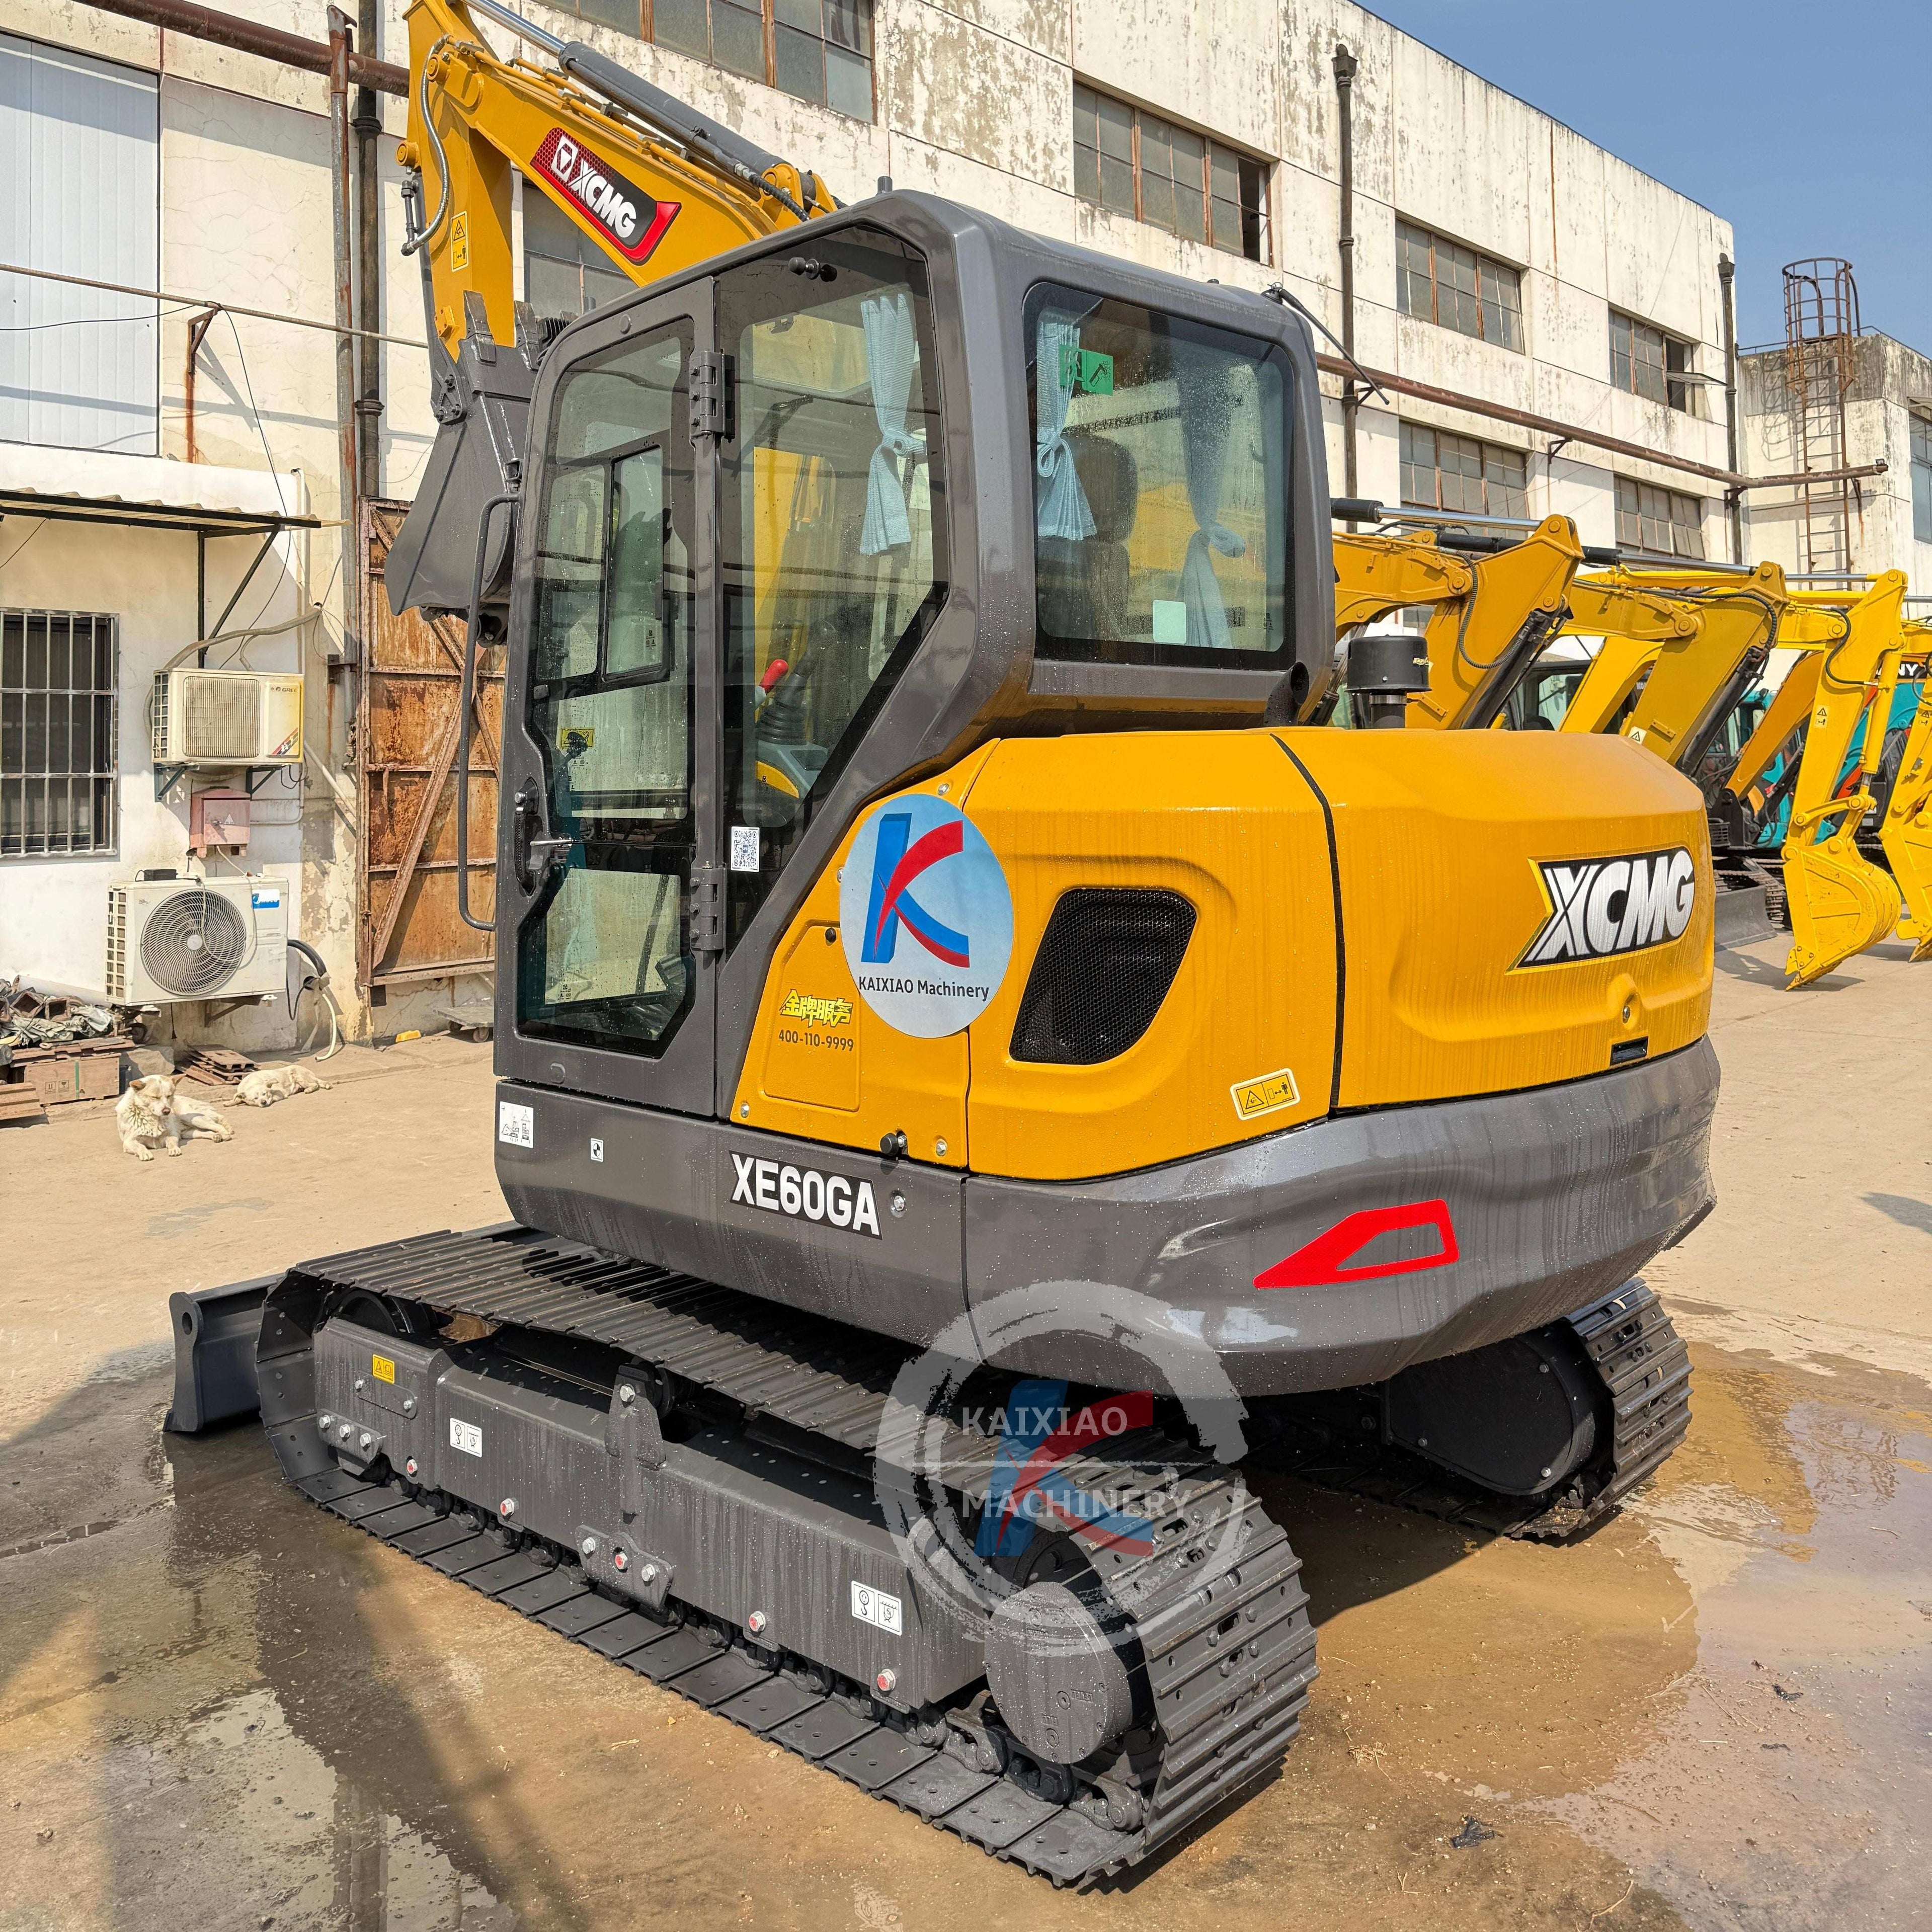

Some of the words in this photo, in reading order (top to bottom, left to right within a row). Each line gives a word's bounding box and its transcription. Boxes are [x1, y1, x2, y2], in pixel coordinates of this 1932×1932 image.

[568, 158, 636, 238] XCMG
[1523, 850, 1695, 962] XCMG
[780, 989, 854, 1027] 金牌服务
[859, 976, 914, 994] KAIXIAO
[918, 980, 989, 1002] Machinery
[778, 1029, 854, 1052] 400-110-9999
[732, 1154, 879, 1236] XE60GA
